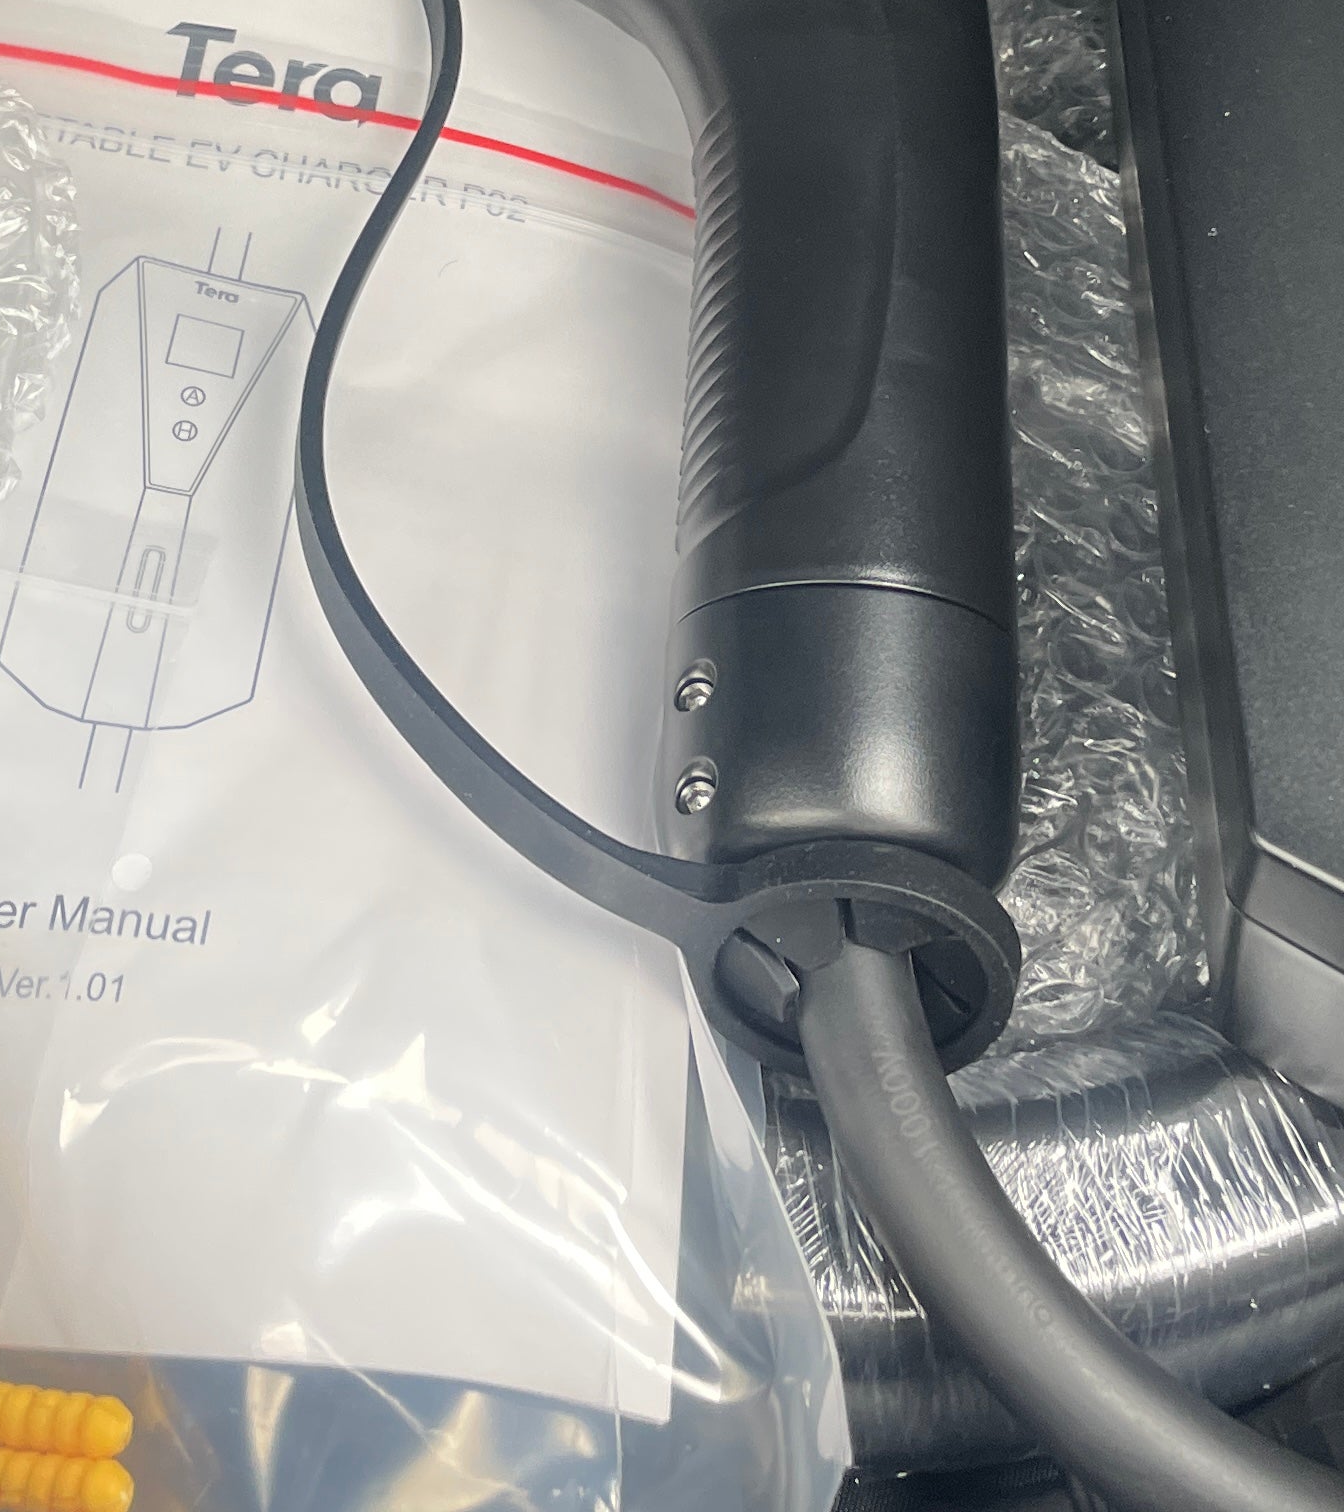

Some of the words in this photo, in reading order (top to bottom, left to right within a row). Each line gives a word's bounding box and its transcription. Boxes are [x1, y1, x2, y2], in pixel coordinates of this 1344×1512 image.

[164, 21, 384, 129] Tera
[185, 140, 243, 173] EV
[194, 280, 240, 305] Tera
[48, 893, 212, 946] Manual
